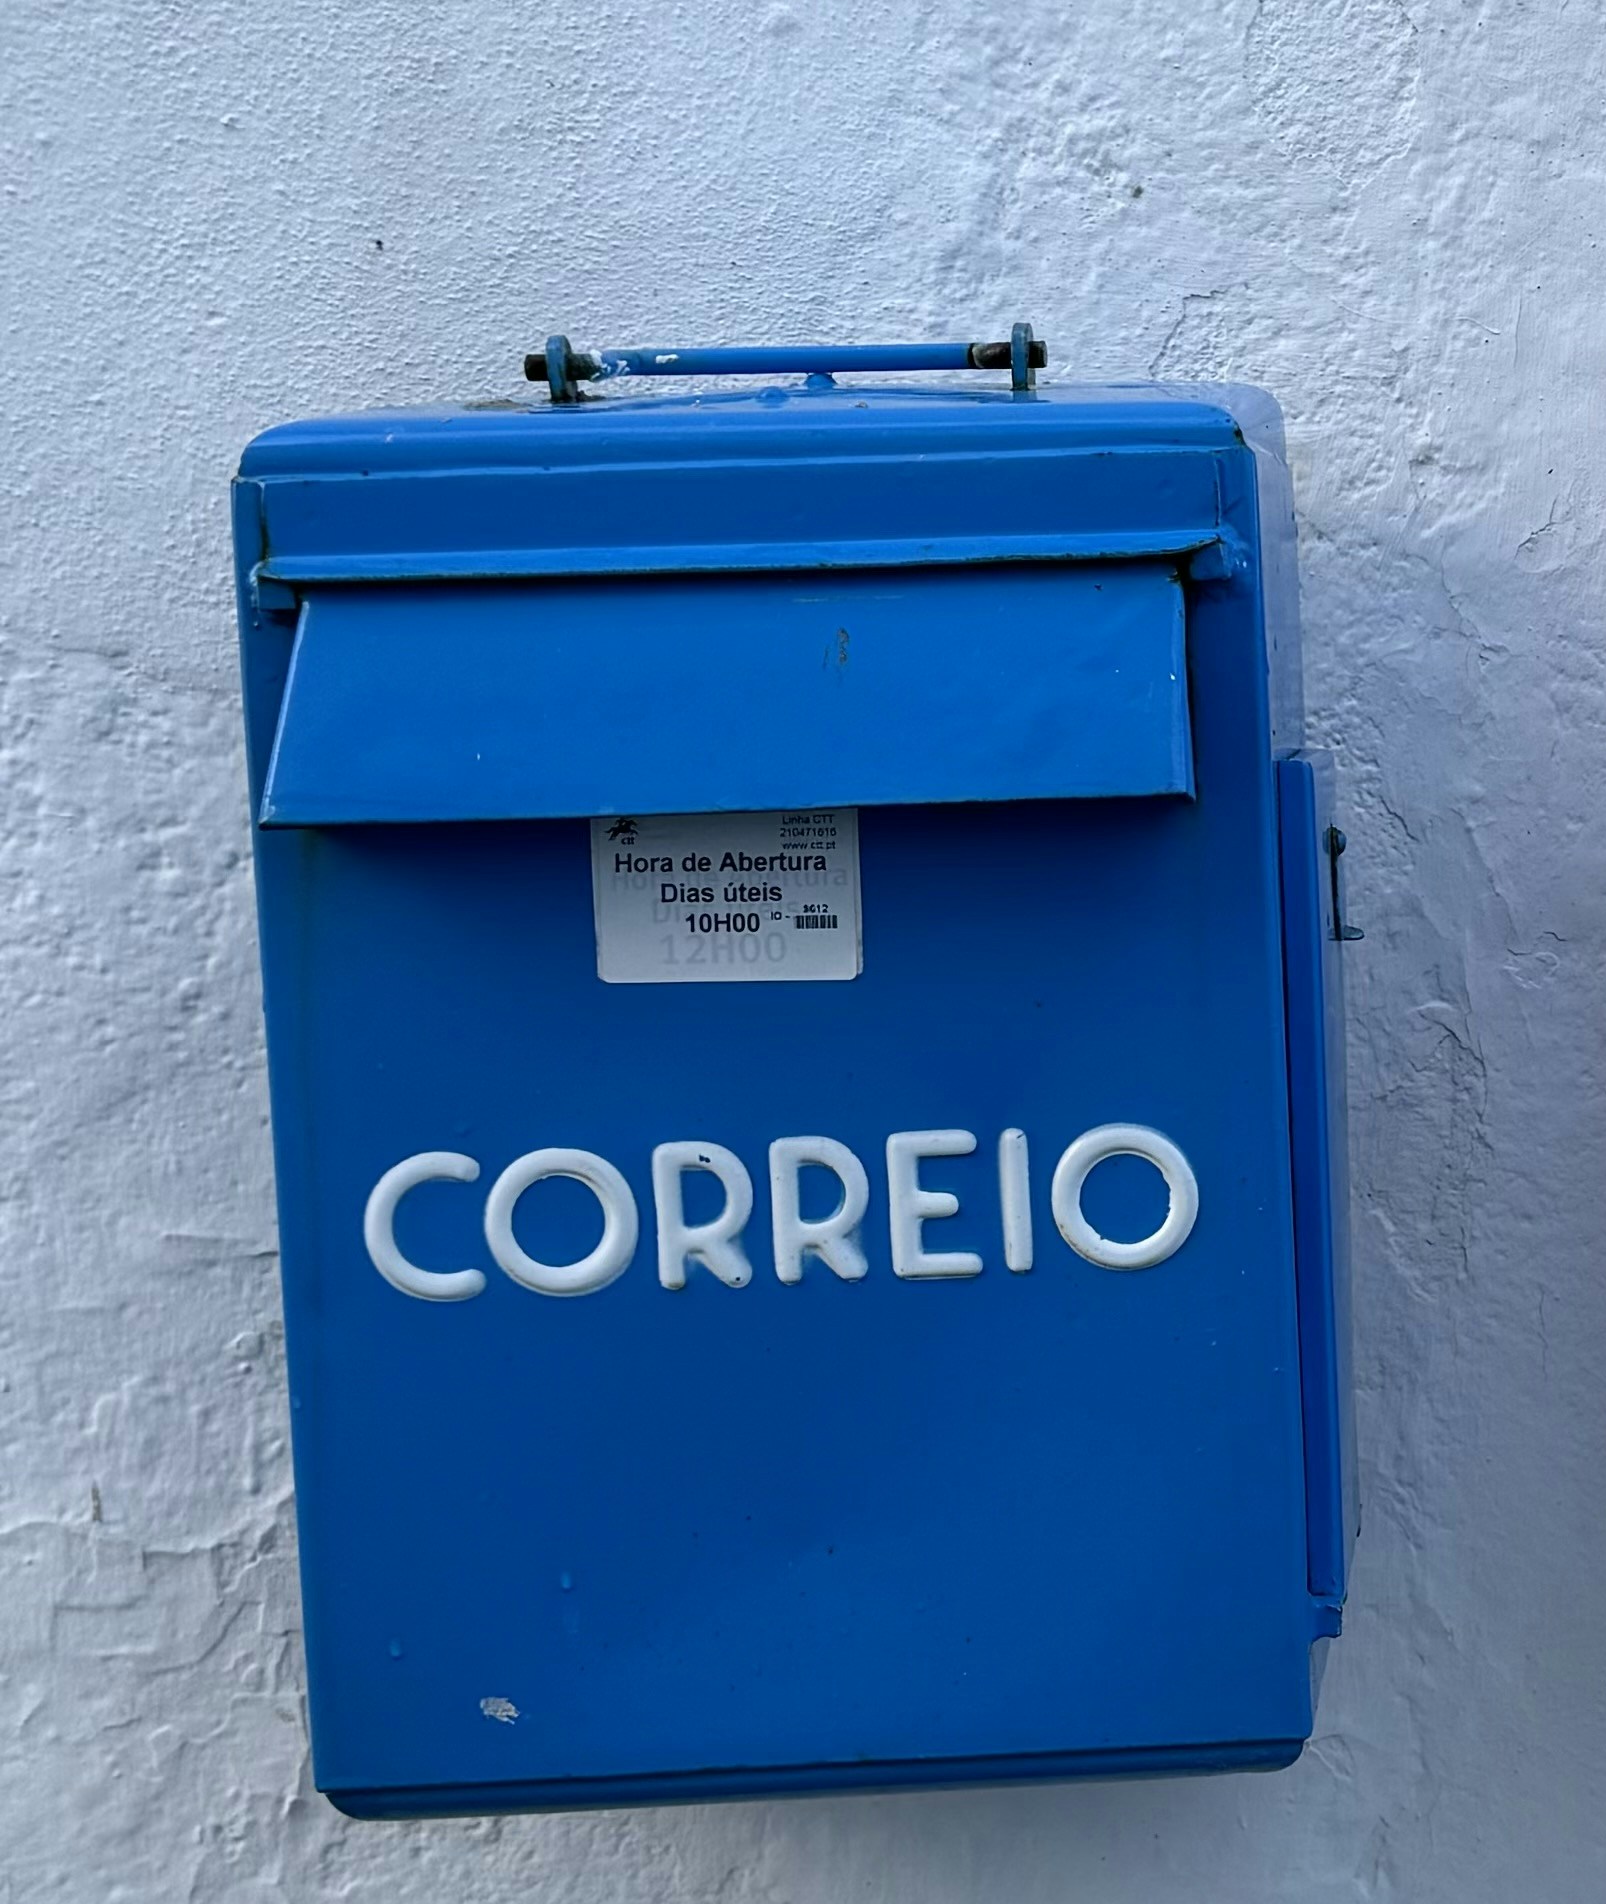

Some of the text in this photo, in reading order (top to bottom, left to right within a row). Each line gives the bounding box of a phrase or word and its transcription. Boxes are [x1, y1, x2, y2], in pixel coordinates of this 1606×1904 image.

[812, 814, 835, 824] CTT
[615, 852, 827, 873] Hora de Abertura
[660, 882, 783, 903] Dias úteis
[685, 912, 760, 933] 10H00
[363, 1121, 1200, 1302] CORREIO
